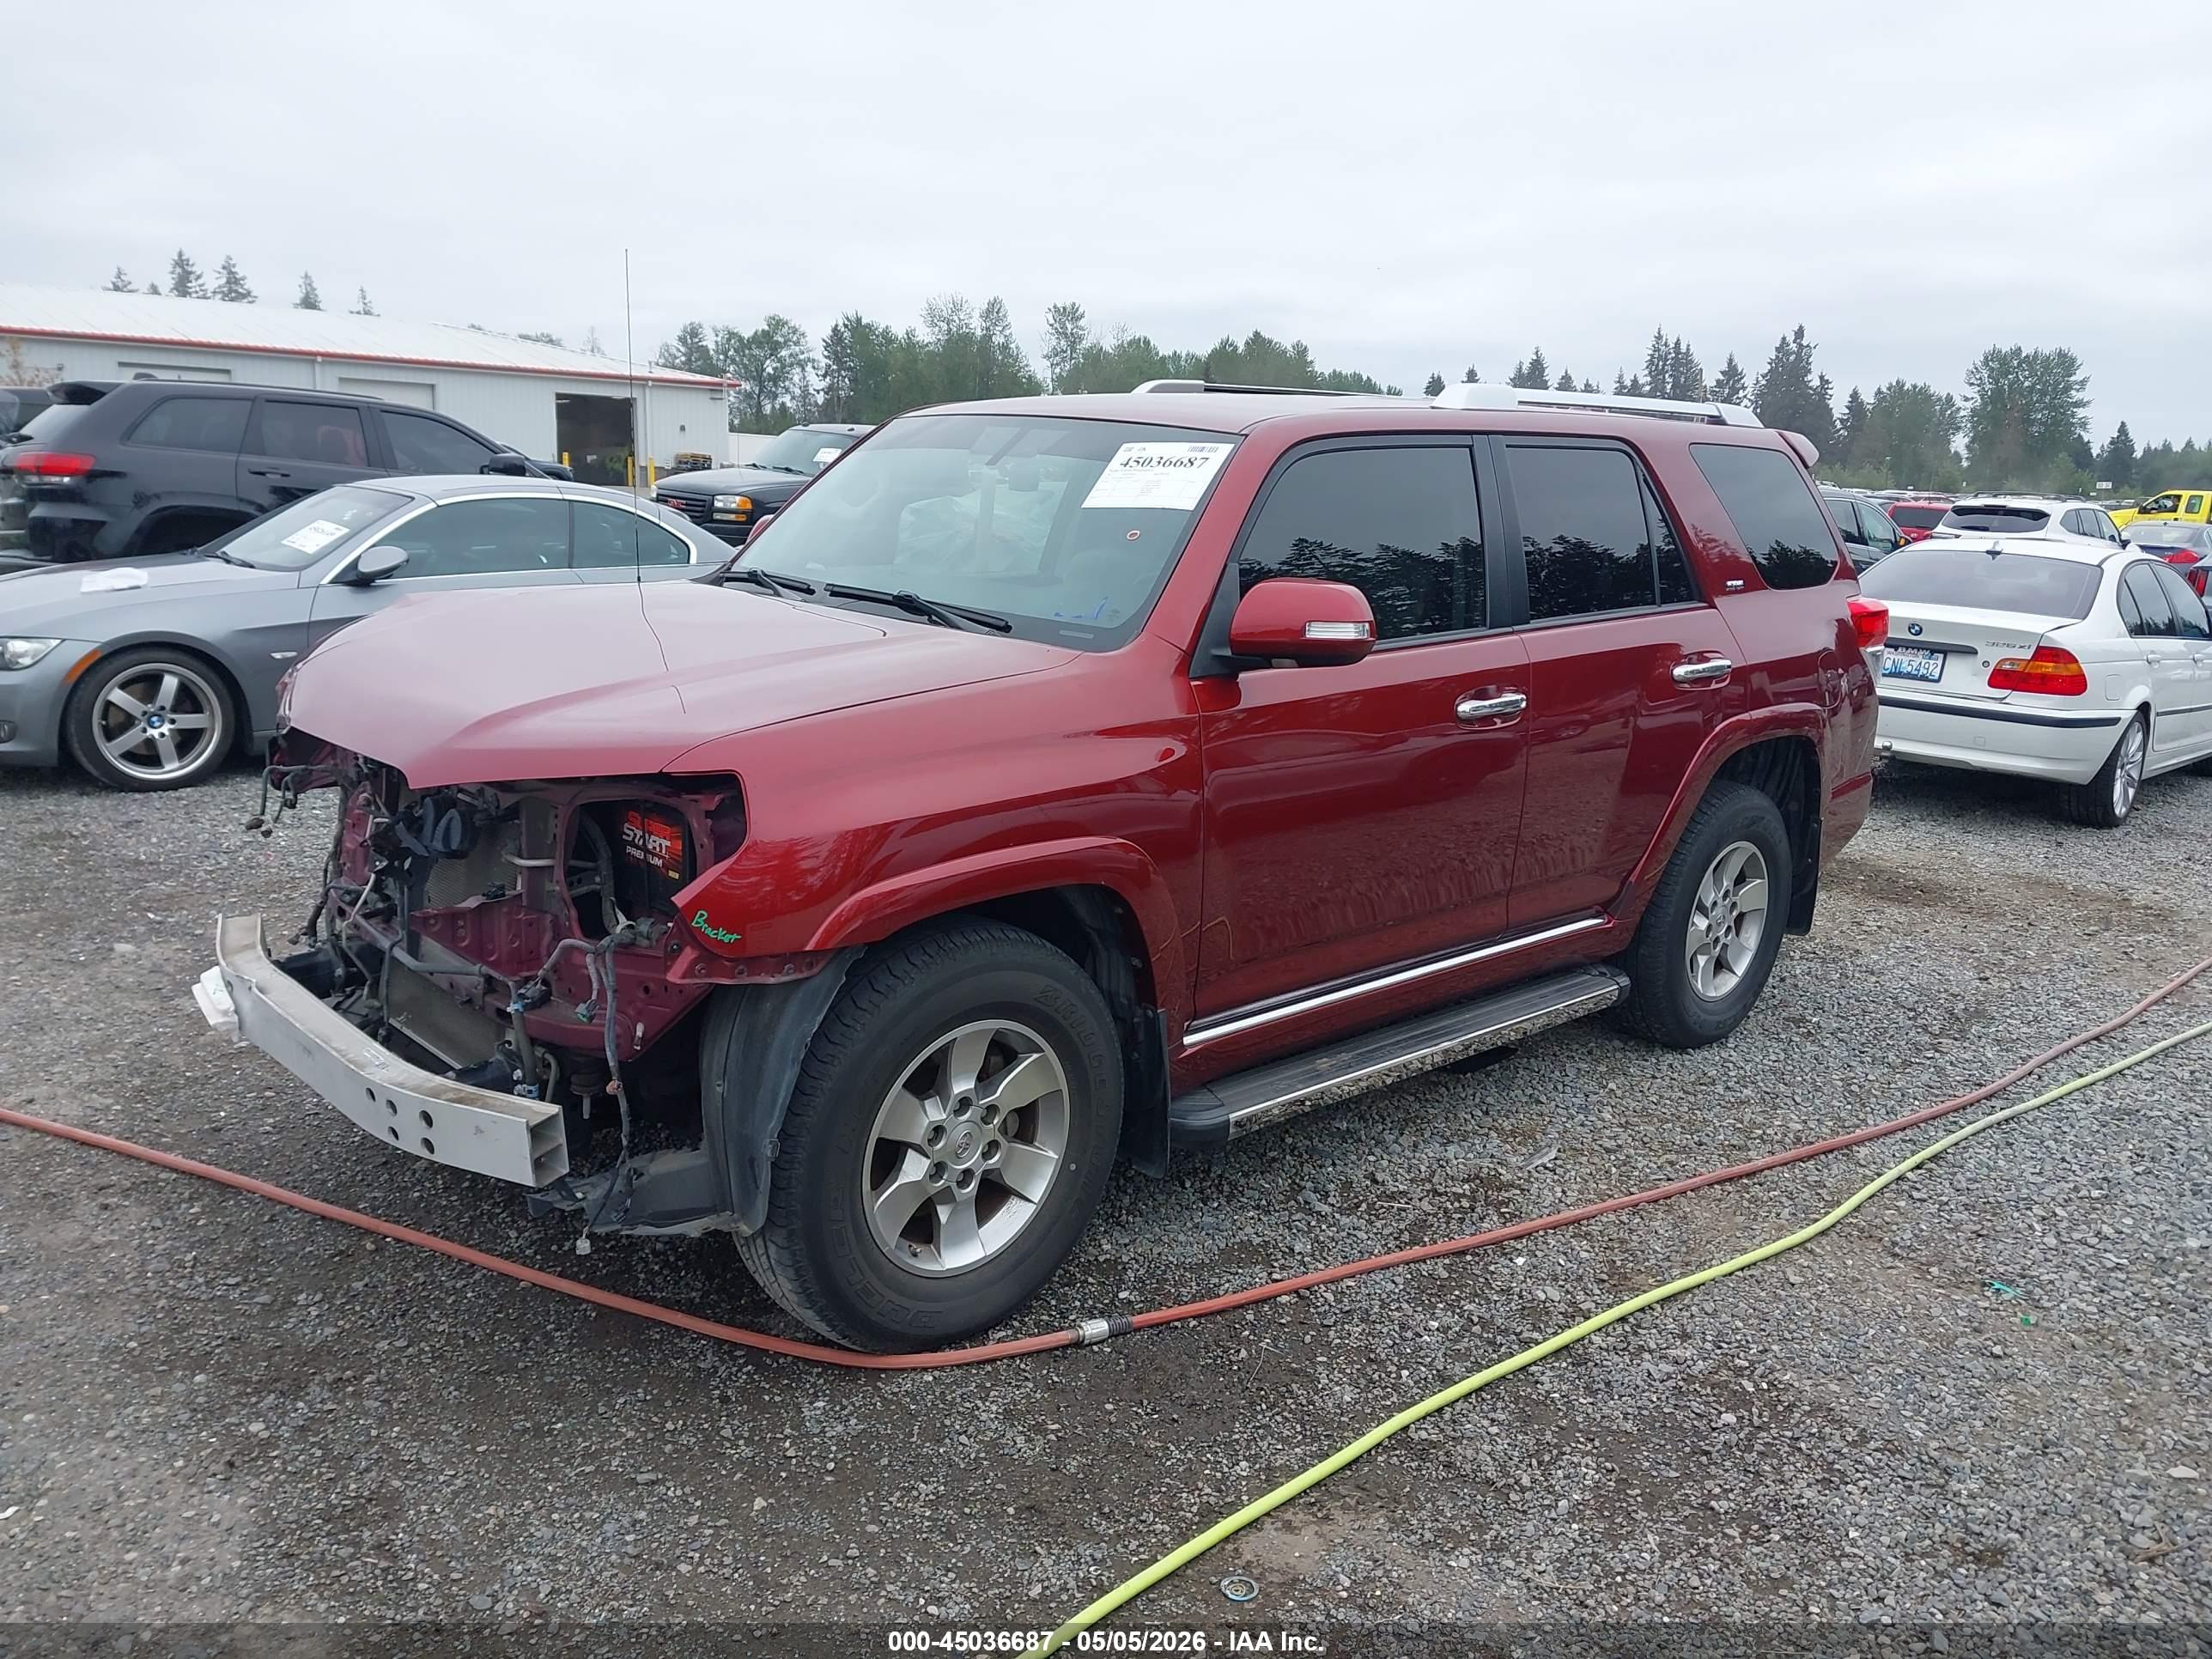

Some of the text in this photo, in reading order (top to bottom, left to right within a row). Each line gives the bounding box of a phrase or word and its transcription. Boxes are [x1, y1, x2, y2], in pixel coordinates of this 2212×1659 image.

[1119, 455, 1211, 470] 45036687
[1882, 656, 1939, 678] CNL5492
[622, 823, 672, 854] START
